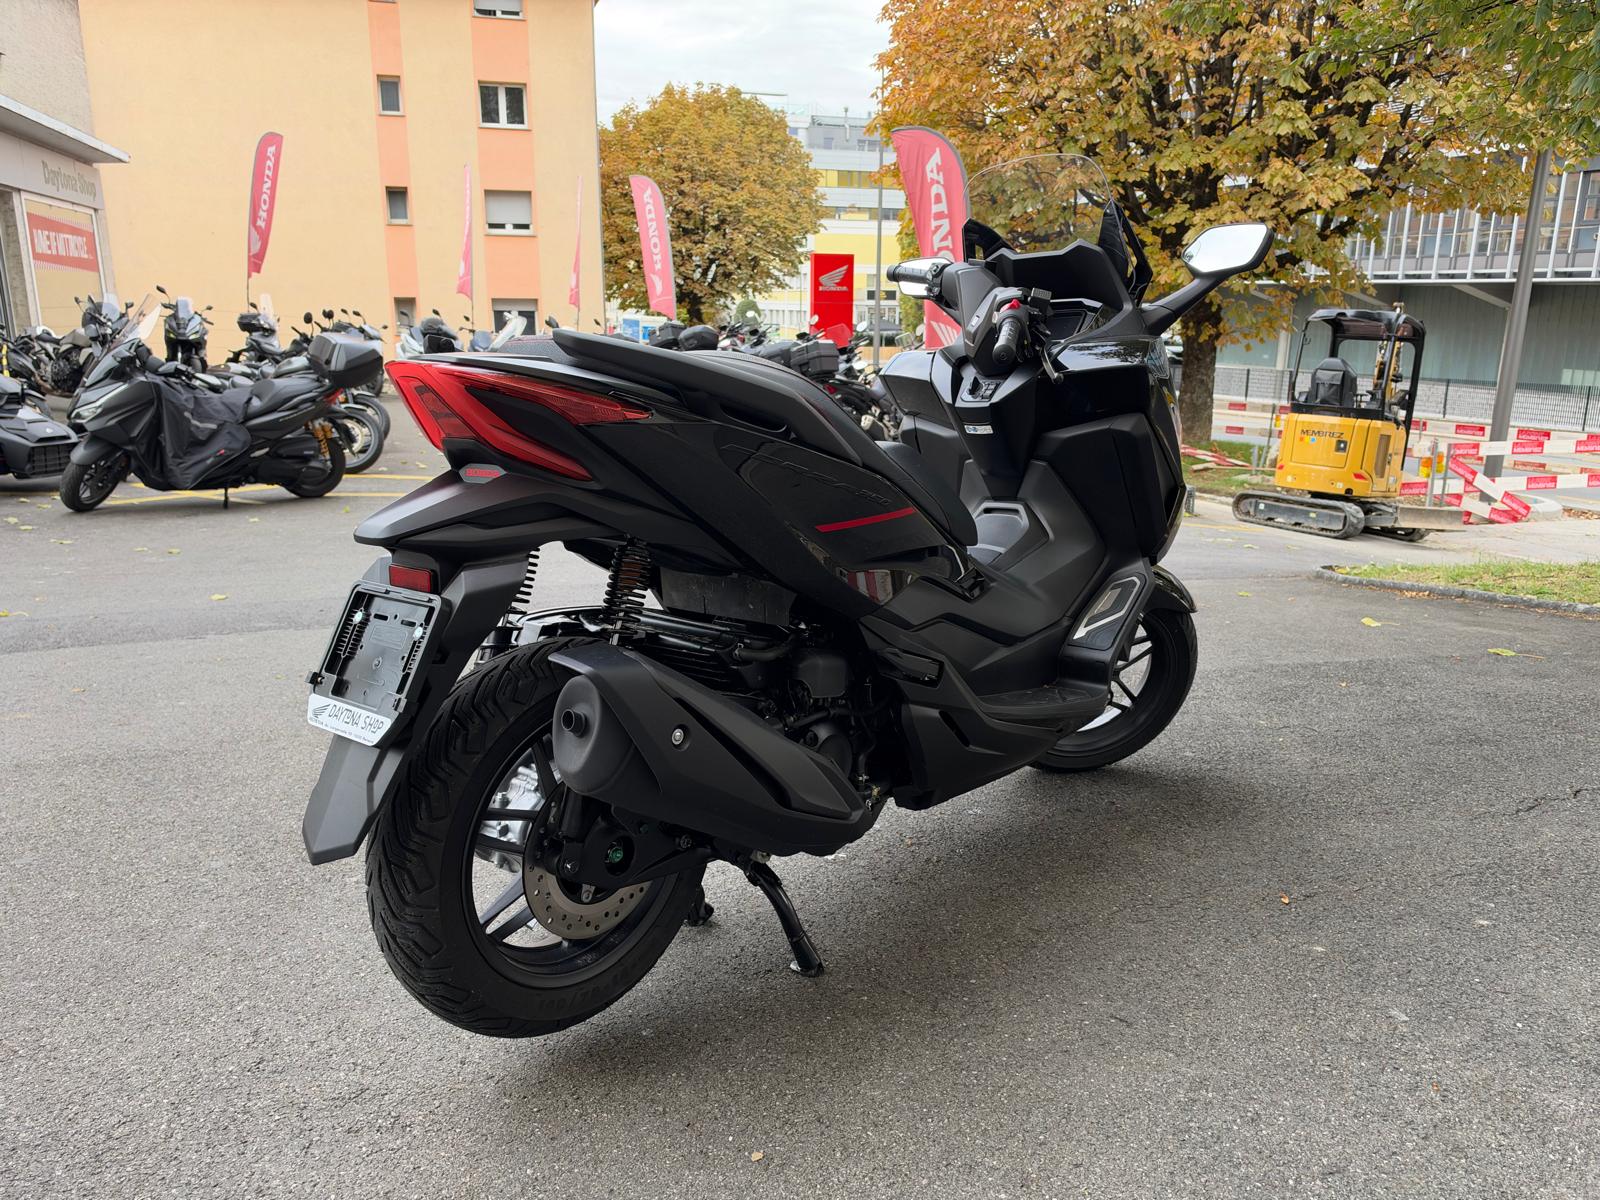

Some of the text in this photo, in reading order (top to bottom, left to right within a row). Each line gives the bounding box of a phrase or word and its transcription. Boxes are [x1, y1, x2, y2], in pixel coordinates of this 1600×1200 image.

[256, 145, 276, 230] HONDA
[643, 187, 662, 271] HONDA
[926, 148, 955, 263] NDA
[1301, 429, 1344, 439] MEMBREZ
[328, 704, 361, 727] DAYTONA
[361, 715, 384, 734] SHOP
